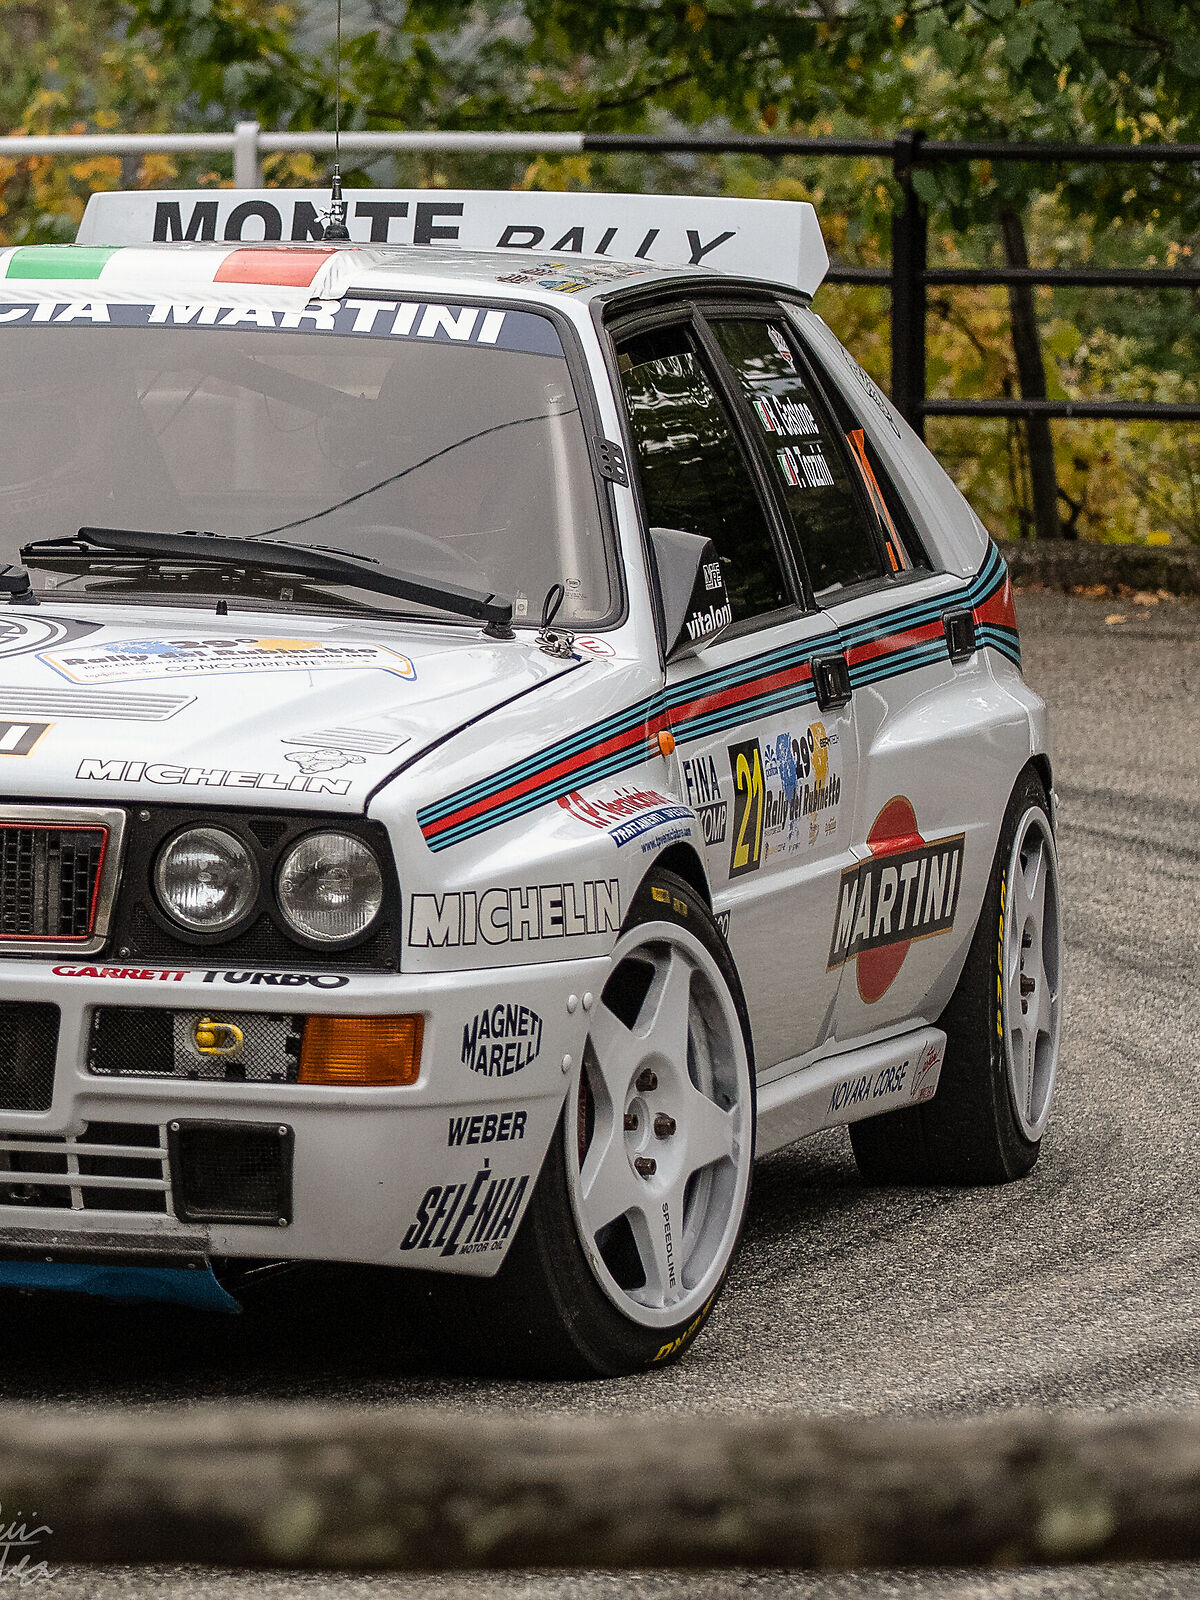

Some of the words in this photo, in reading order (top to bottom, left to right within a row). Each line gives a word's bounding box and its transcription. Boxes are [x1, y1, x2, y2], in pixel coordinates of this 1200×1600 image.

[153, 200, 464, 244] MONTE
[147, 300, 507, 344] MARTINI
[686, 597, 732, 640] vitaloni
[62, 654, 148, 666] Rally
[158, 650, 207, 659] del
[215, 648, 378, 656] Rubinetto
[165, 659, 322, 673] CONCORRENTE
[75, 759, 352, 795] MICHELIN
[682, 755, 721, 806] FINA
[733, 748, 763, 868] 21
[765, 789, 788, 830] Rally
[803, 773, 840, 816] Rubinetto
[612, 809, 665, 843] TRATTAMENTI
[408, 878, 621, 947] MICHELIN
[834, 850, 959, 953] MARTINI
[52, 965, 191, 981] GARRETT
[200, 970, 350, 989] TURBO
[461, 1003, 542, 1056] MAGNETI
[461, 1038, 542, 1077] MARELLI
[827, 1074, 873, 1115] NOVARA
[873, 1061, 909, 1098] CORSE
[448, 1111, 527, 1146] WEBER
[458, 1241, 488, 1255] MOTOR
[662, 1202, 676, 1288] SPEEDLINE
